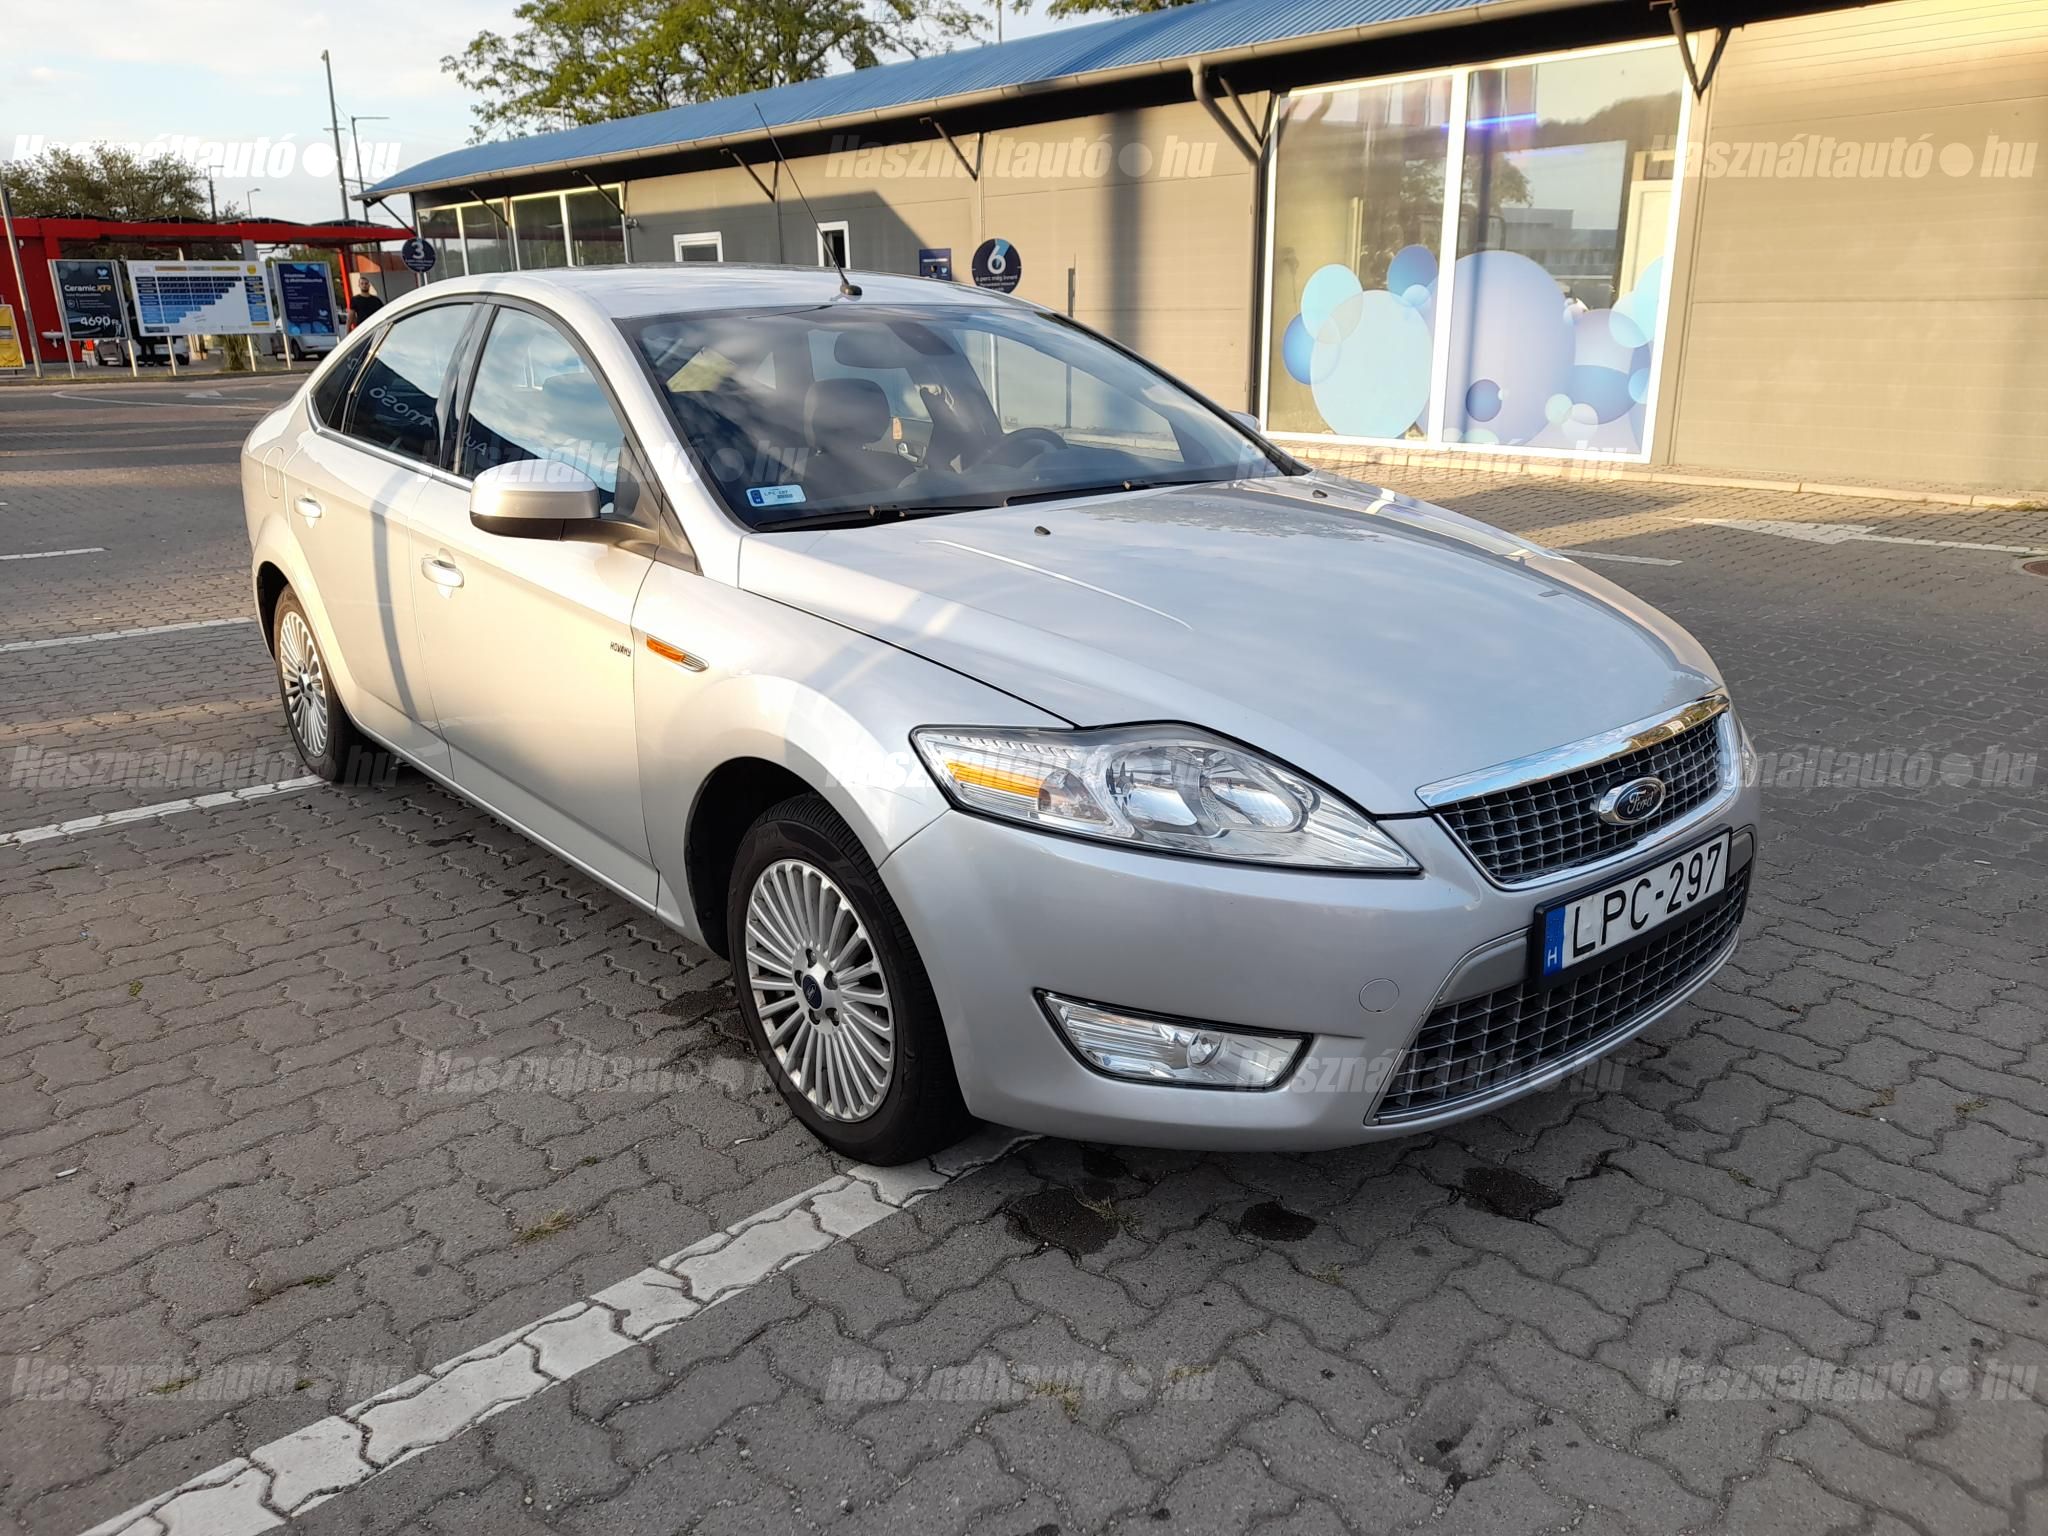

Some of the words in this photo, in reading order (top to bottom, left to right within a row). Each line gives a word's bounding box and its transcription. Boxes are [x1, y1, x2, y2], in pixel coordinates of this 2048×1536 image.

[411, 242, 424, 259] 3
[987, 245, 1006, 274] 6
[80, 316, 111, 326] 4690
[1627, 790, 1653, 814] Ford
[1573, 841, 1722, 958] LPC-297
[1547, 946, 1557, 967] H
